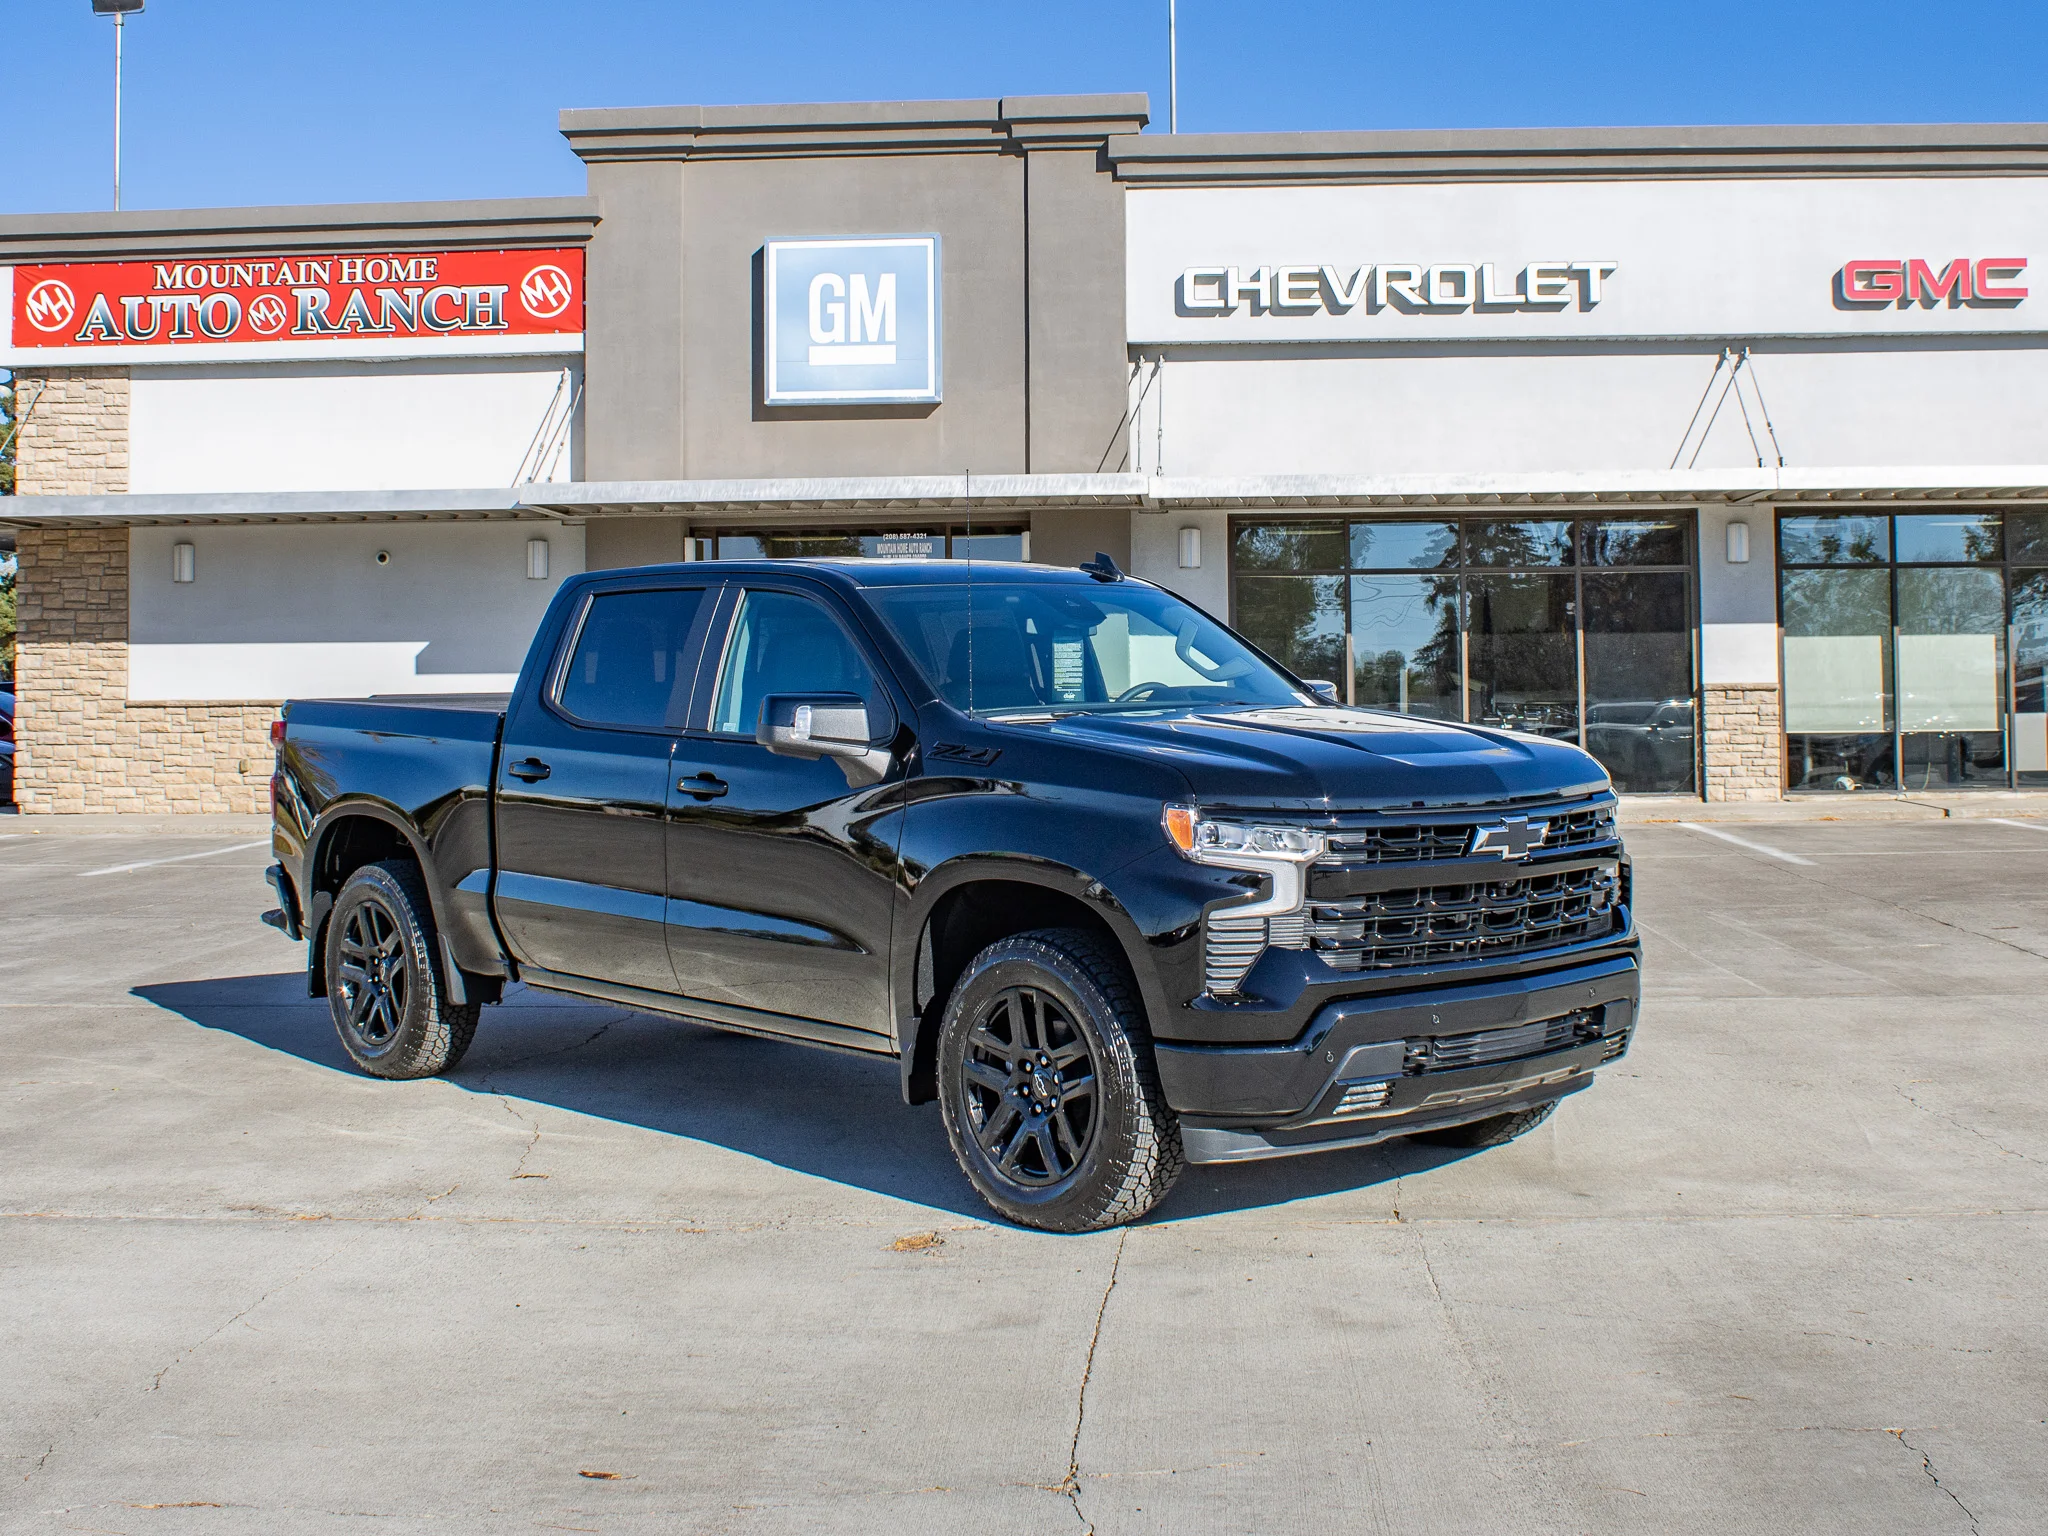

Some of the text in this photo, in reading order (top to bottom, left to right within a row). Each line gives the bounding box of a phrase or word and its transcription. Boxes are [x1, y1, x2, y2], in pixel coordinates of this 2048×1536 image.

[153, 257, 439, 290] MOUNTAIN HOME
[1182, 260, 1619, 309] CHEVROLET
[1843, 257, 2029, 301] GMC
[74, 292, 243, 342] AUTO
[290, 284, 509, 335] RANCH
[808, 272, 897, 344] GM
[876, 543, 896, 555] MOUNTAIN
[882, 532, 927, 541] (208) 587-4321
